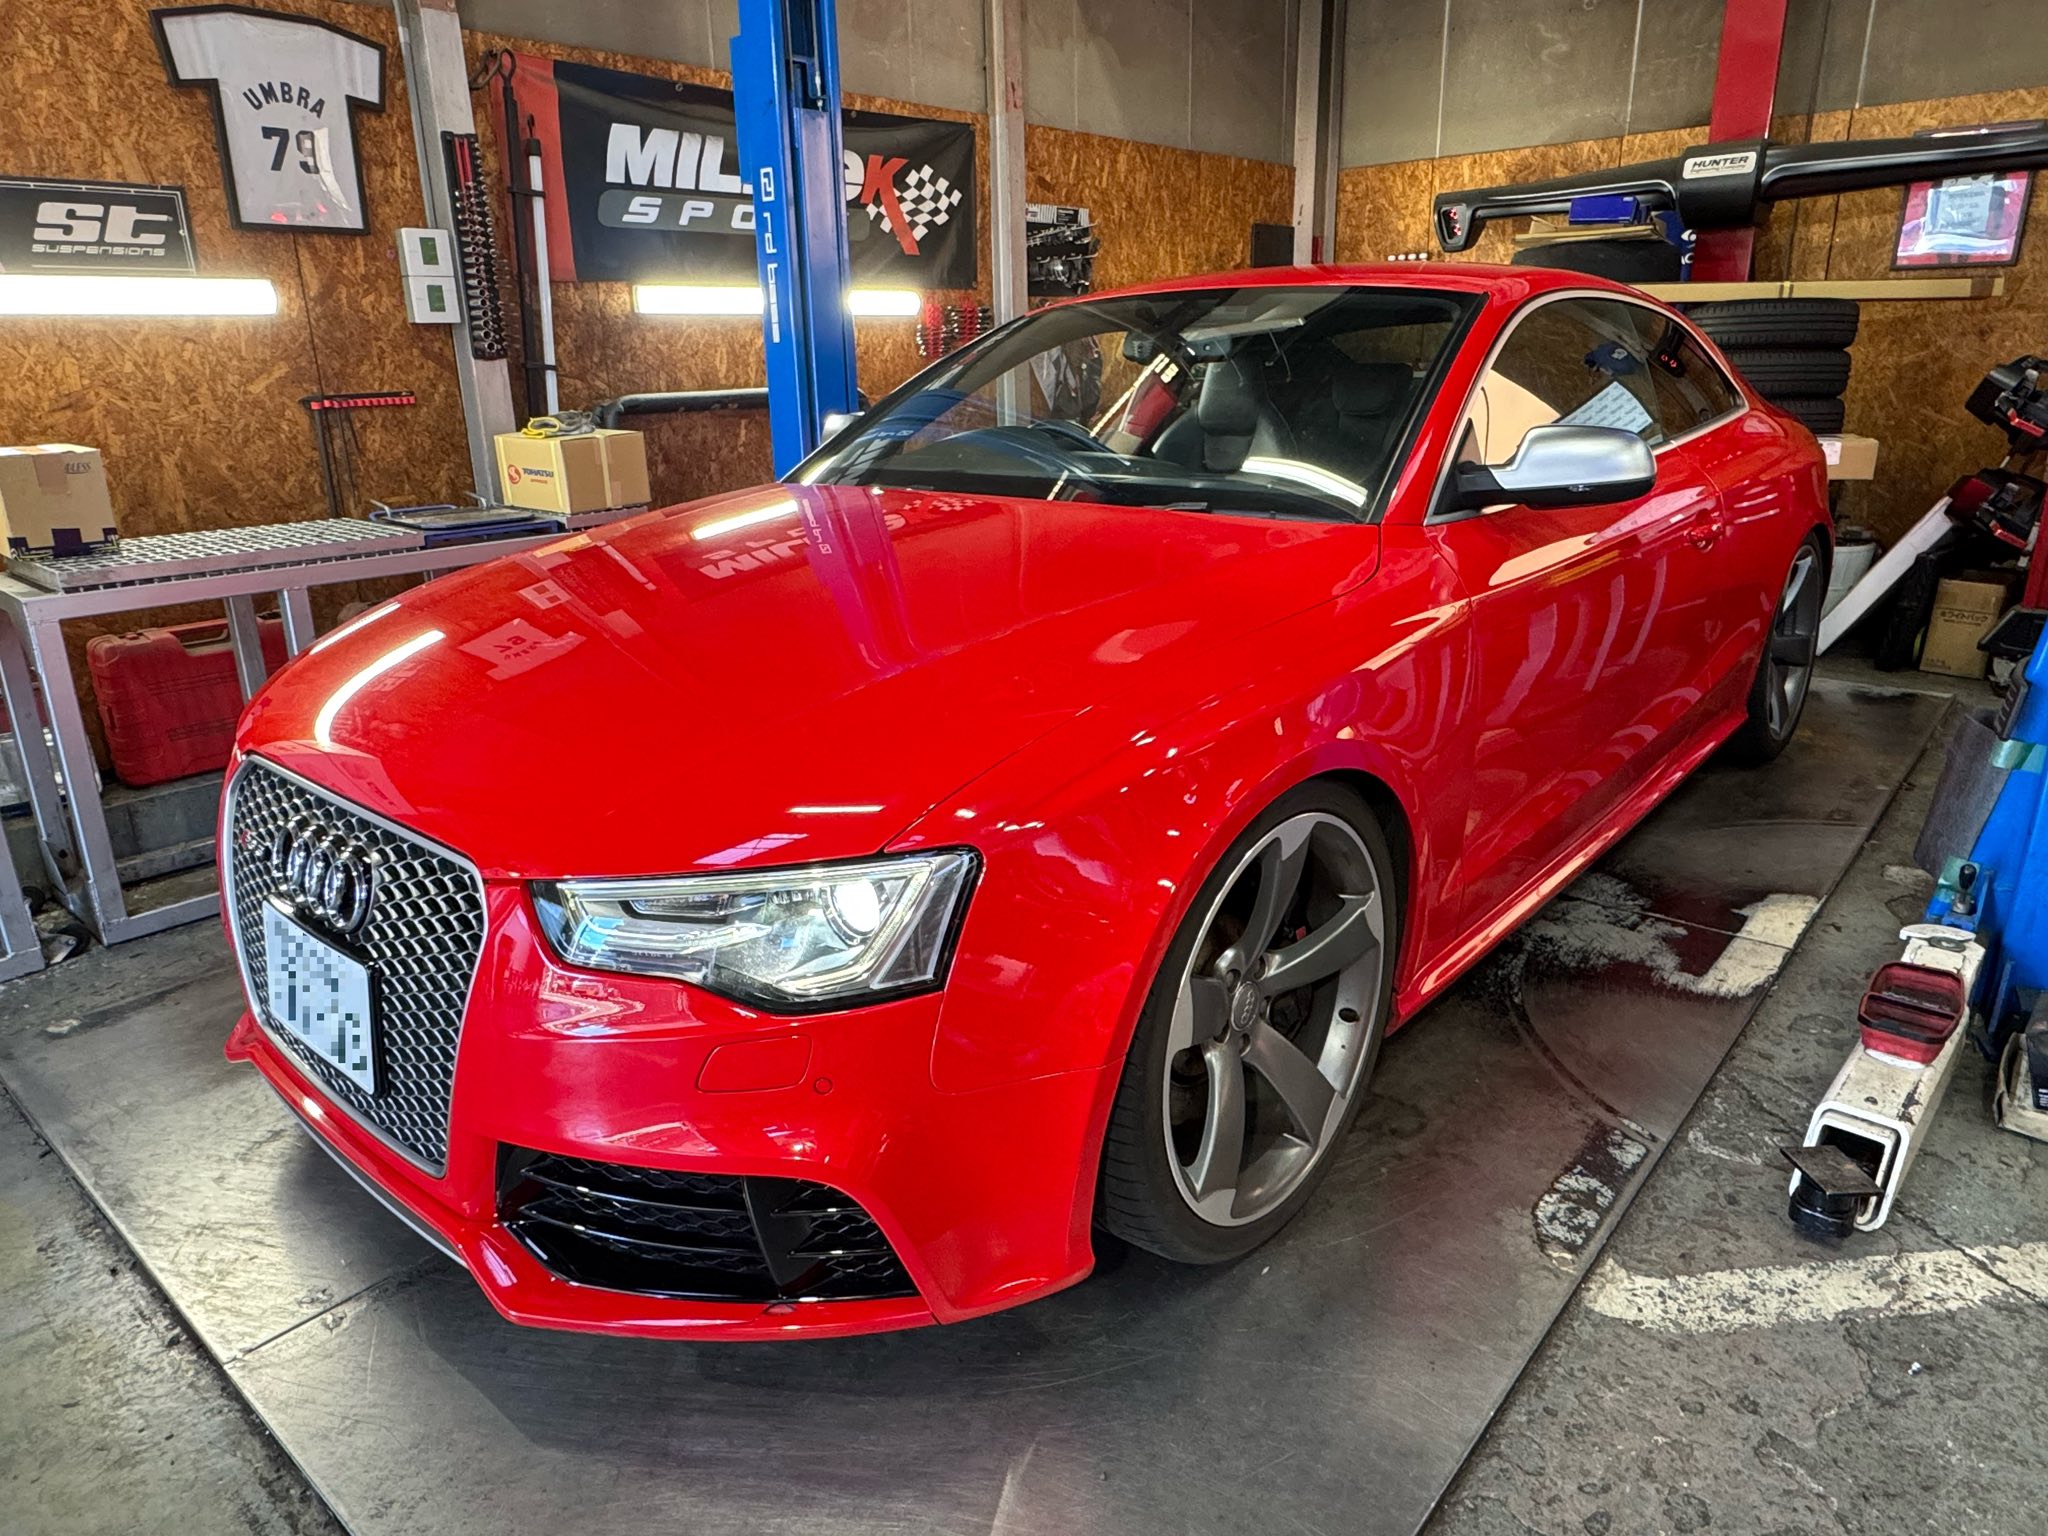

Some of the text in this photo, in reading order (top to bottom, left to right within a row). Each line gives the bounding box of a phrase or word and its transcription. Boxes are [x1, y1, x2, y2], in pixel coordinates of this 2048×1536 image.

[242, 81, 325, 119] UMBRA
[261, 126, 320, 174] 79
[1692, 156, 1749, 169] HUNTER
[622, 196, 757, 230] SPO
[31, 243, 166, 257] SUSPENSIONS
